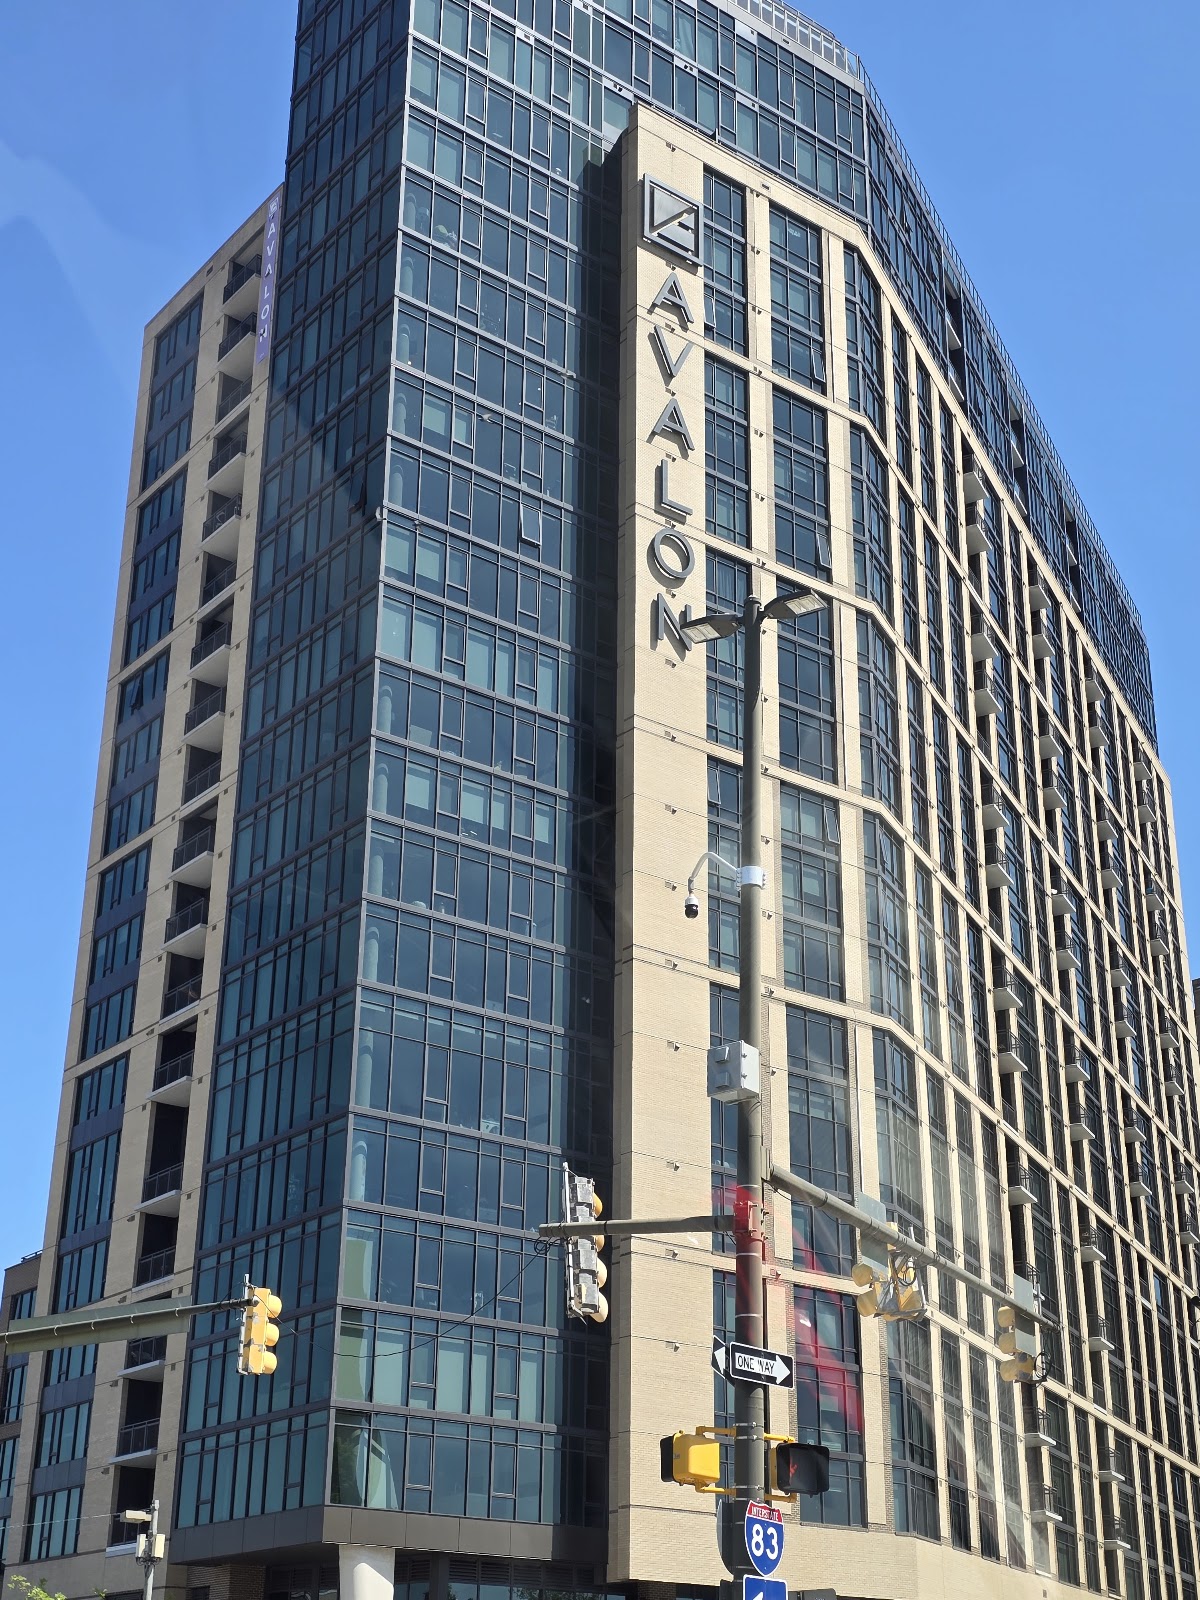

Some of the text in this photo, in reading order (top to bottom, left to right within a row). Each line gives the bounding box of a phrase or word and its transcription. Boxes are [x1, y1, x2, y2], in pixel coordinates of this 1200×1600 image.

[259, 222, 276, 342] AVALON
[653, 272, 695, 651] AVALON
[737, 1355, 775, 1375] ONE WAY
[751, 1506, 778, 1520] INTERSTATE
[751, 1523, 779, 1560] 83
